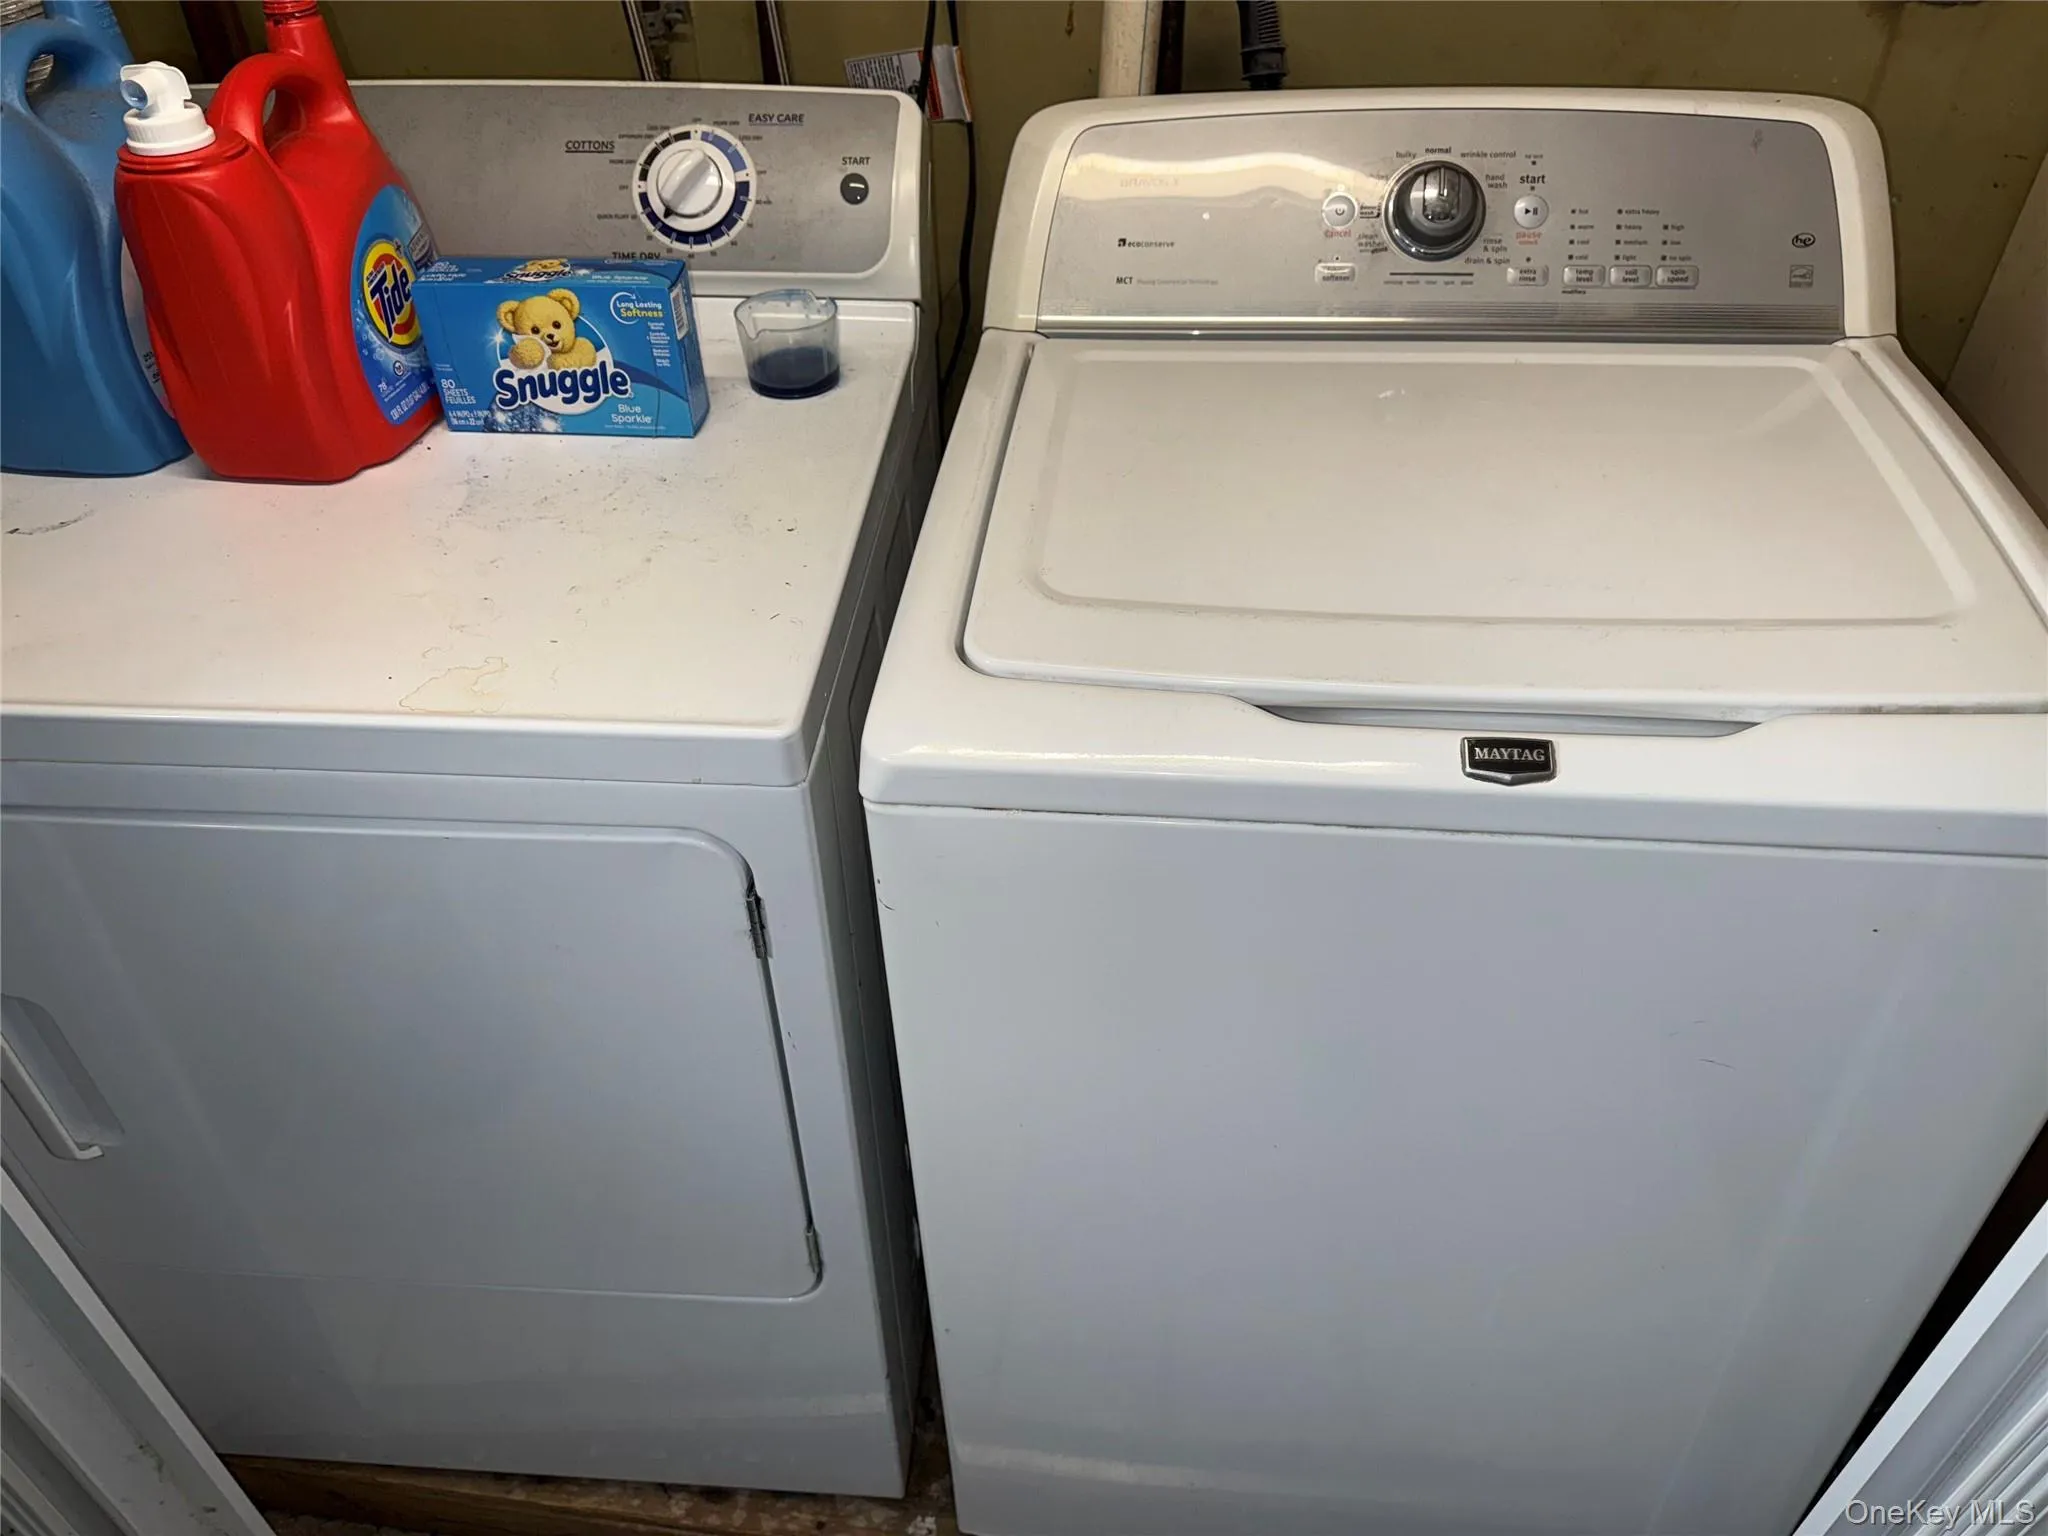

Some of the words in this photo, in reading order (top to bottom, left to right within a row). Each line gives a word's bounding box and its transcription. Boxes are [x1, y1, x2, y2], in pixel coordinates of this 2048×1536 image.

[749, 113, 774, 123] EASY
[777, 113, 805, 123] CARE
[565, 140, 615, 150] COTTONS
[1425, 146, 1451, 154] normal
[1396, 151, 1417, 159] bulky
[842, 156, 871, 166] START
[1519, 174, 1546, 184] start
[1324, 229, 1352, 238] cancel
[1516, 232, 1542, 240] pause
[1128, 240, 1175, 248] ecoconserve
[1358, 241, 1385, 249] washer
[612, 252, 637, 260] TIME
[640, 252, 661, 260] DRY
[1494, 257, 1510, 265] spin
[1576, 269, 1594, 277] temp
[1670, 269, 1686, 277] spin
[1116, 276, 1133, 285] MCT
[1322, 274, 1350, 282] softener
[1667, 275, 1689, 284] speed
[369, 259, 412, 342] Tide
[616, 300, 634, 309] Long
[634, 301, 662, 310] Lasting
[621, 308, 663, 318] Softness
[441, 378, 455, 388] 80
[496, 361, 629, 407] Snuggle
[443, 388, 468, 396] SHEETS
[445, 396, 476, 405] FEUILLES
[618, 404, 641, 413] Blue
[611, 414, 652, 424] Sparkle
[1474, 747, 1545, 761] MAYTAG
